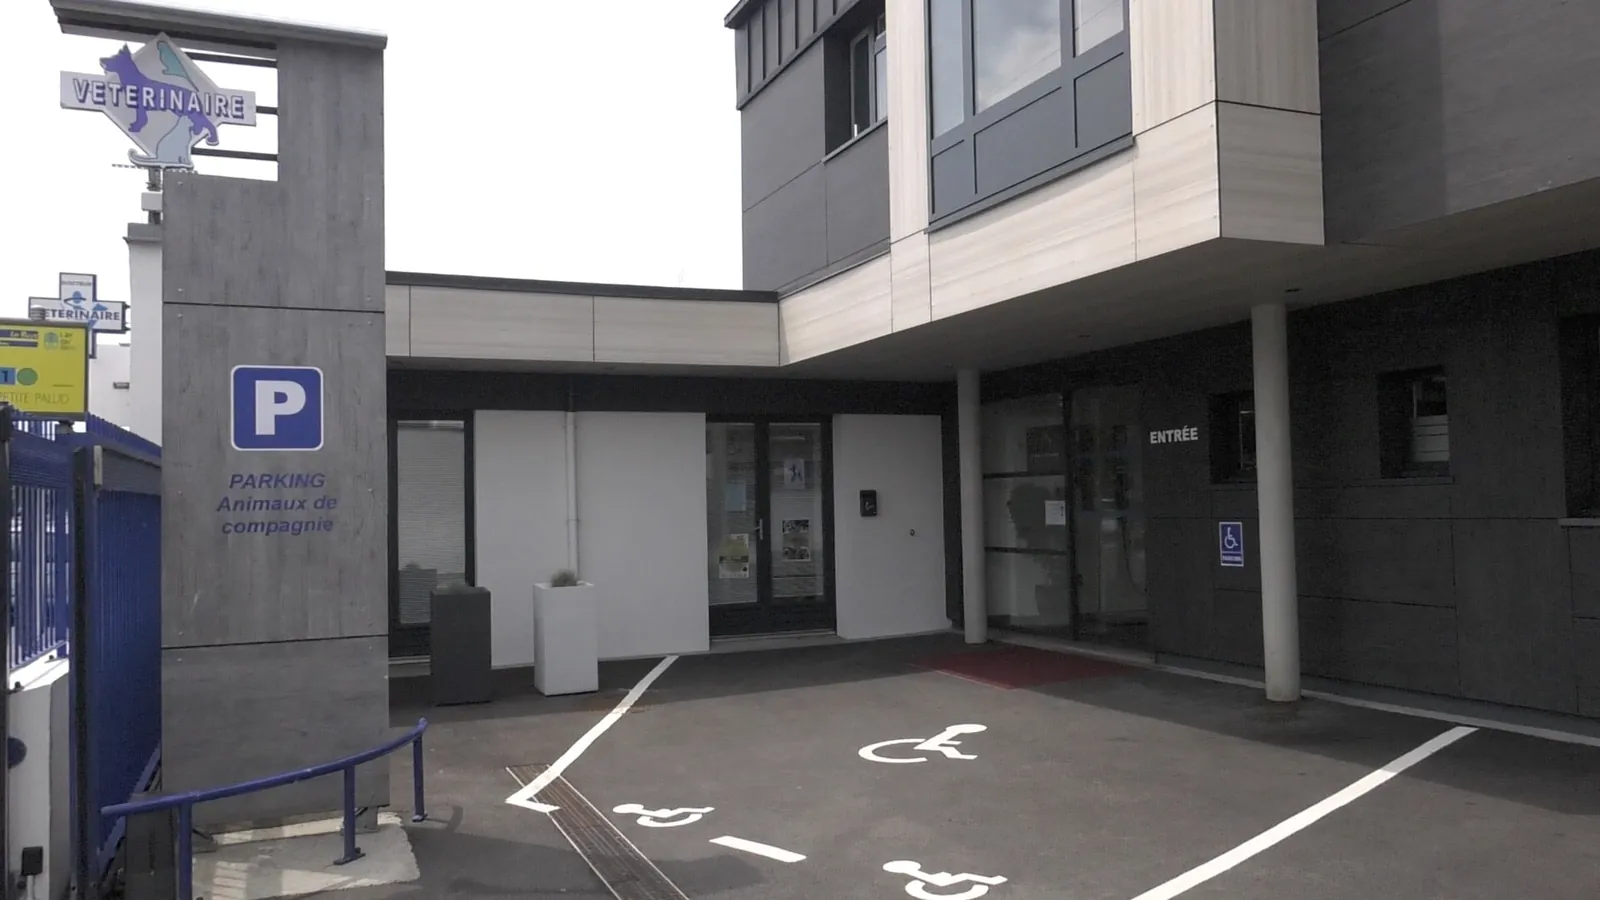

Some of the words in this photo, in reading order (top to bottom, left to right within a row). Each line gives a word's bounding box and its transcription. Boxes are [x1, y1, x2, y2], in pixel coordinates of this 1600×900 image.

[73, 78, 245, 120] VETERINAIRE
[44, 308, 121, 321] ETERINAIRE
[255, 379, 307, 436] P
[1150, 425, 1199, 445] ENTRÉE
[229, 472, 326, 489] PARKING
[216, 496, 308, 512] Animaux
[313, 494, 338, 510] de
[222, 516, 334, 537] compagnie
